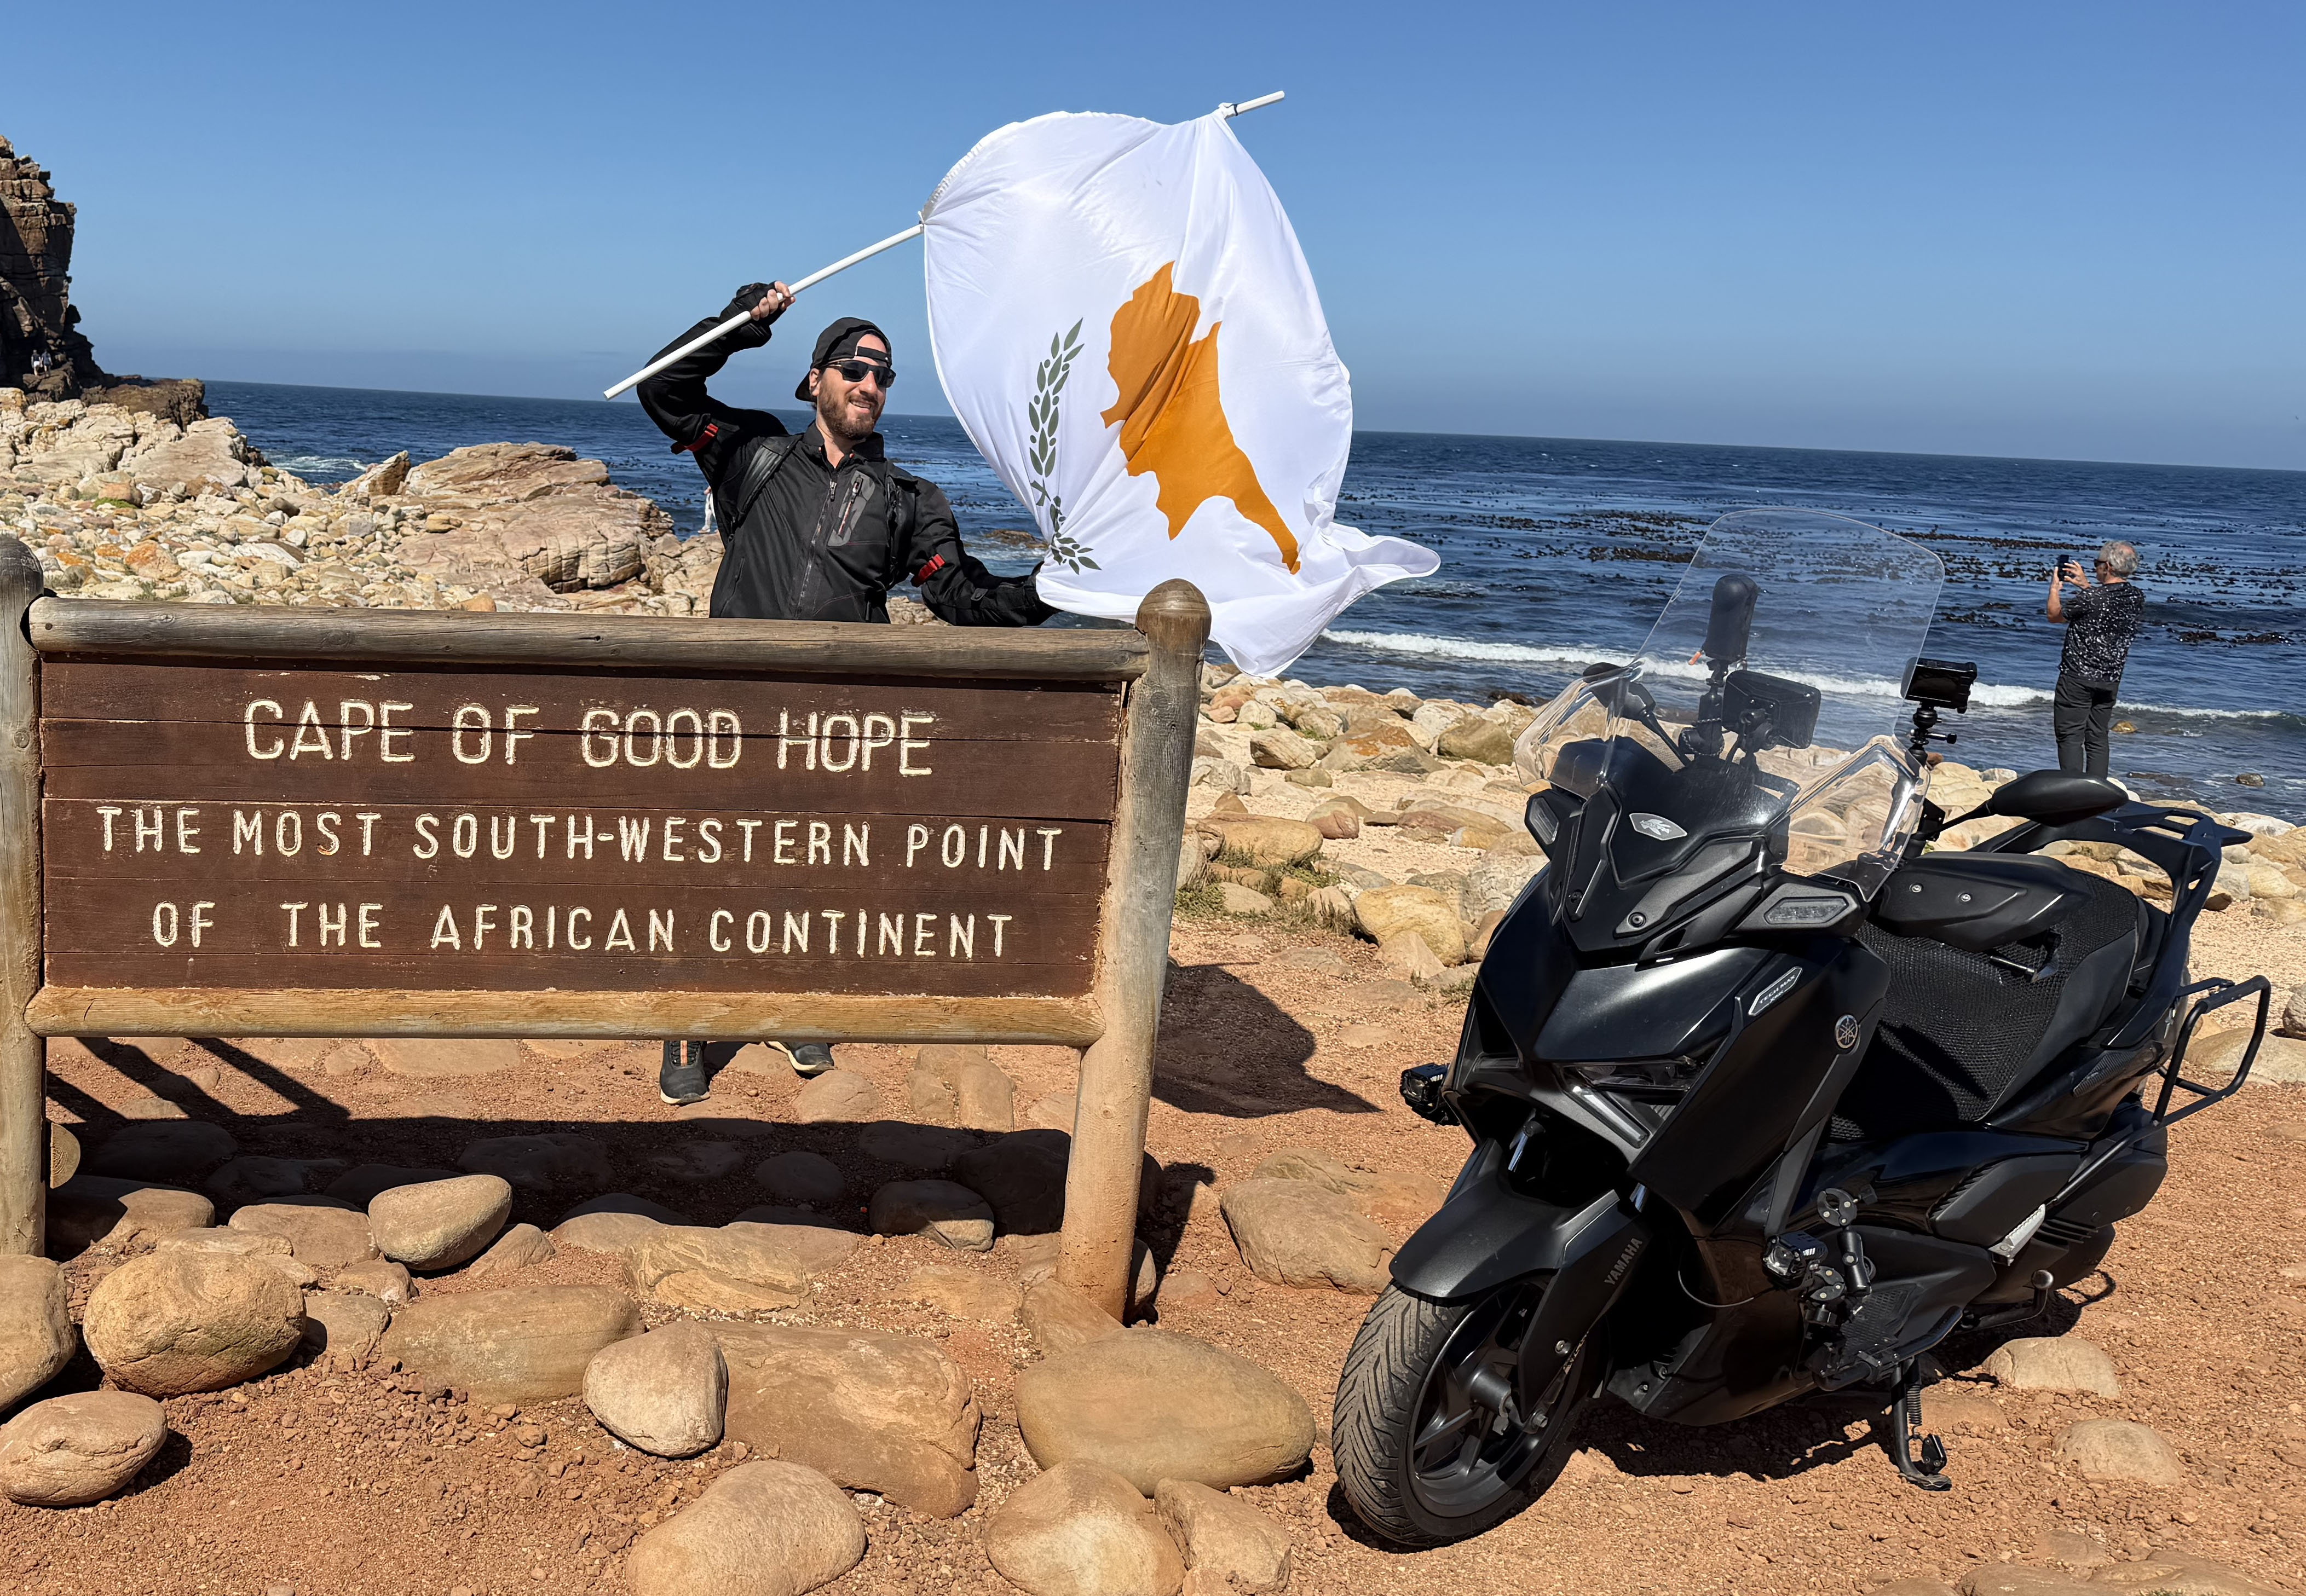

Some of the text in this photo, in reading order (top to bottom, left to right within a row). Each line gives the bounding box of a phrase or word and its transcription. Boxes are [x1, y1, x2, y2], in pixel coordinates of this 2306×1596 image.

[244, 698, 935, 777] CAPE OF GOOD HOPE
[96, 806, 1062, 871] THE MOST SOUTH-WESTERN POINT
[152, 900, 1012, 959] OF THE AFRICAN CONTINENT
[1760, 975, 1795, 1003] TECH MAX
[1604, 1238, 1643, 1285] YAMAHA
